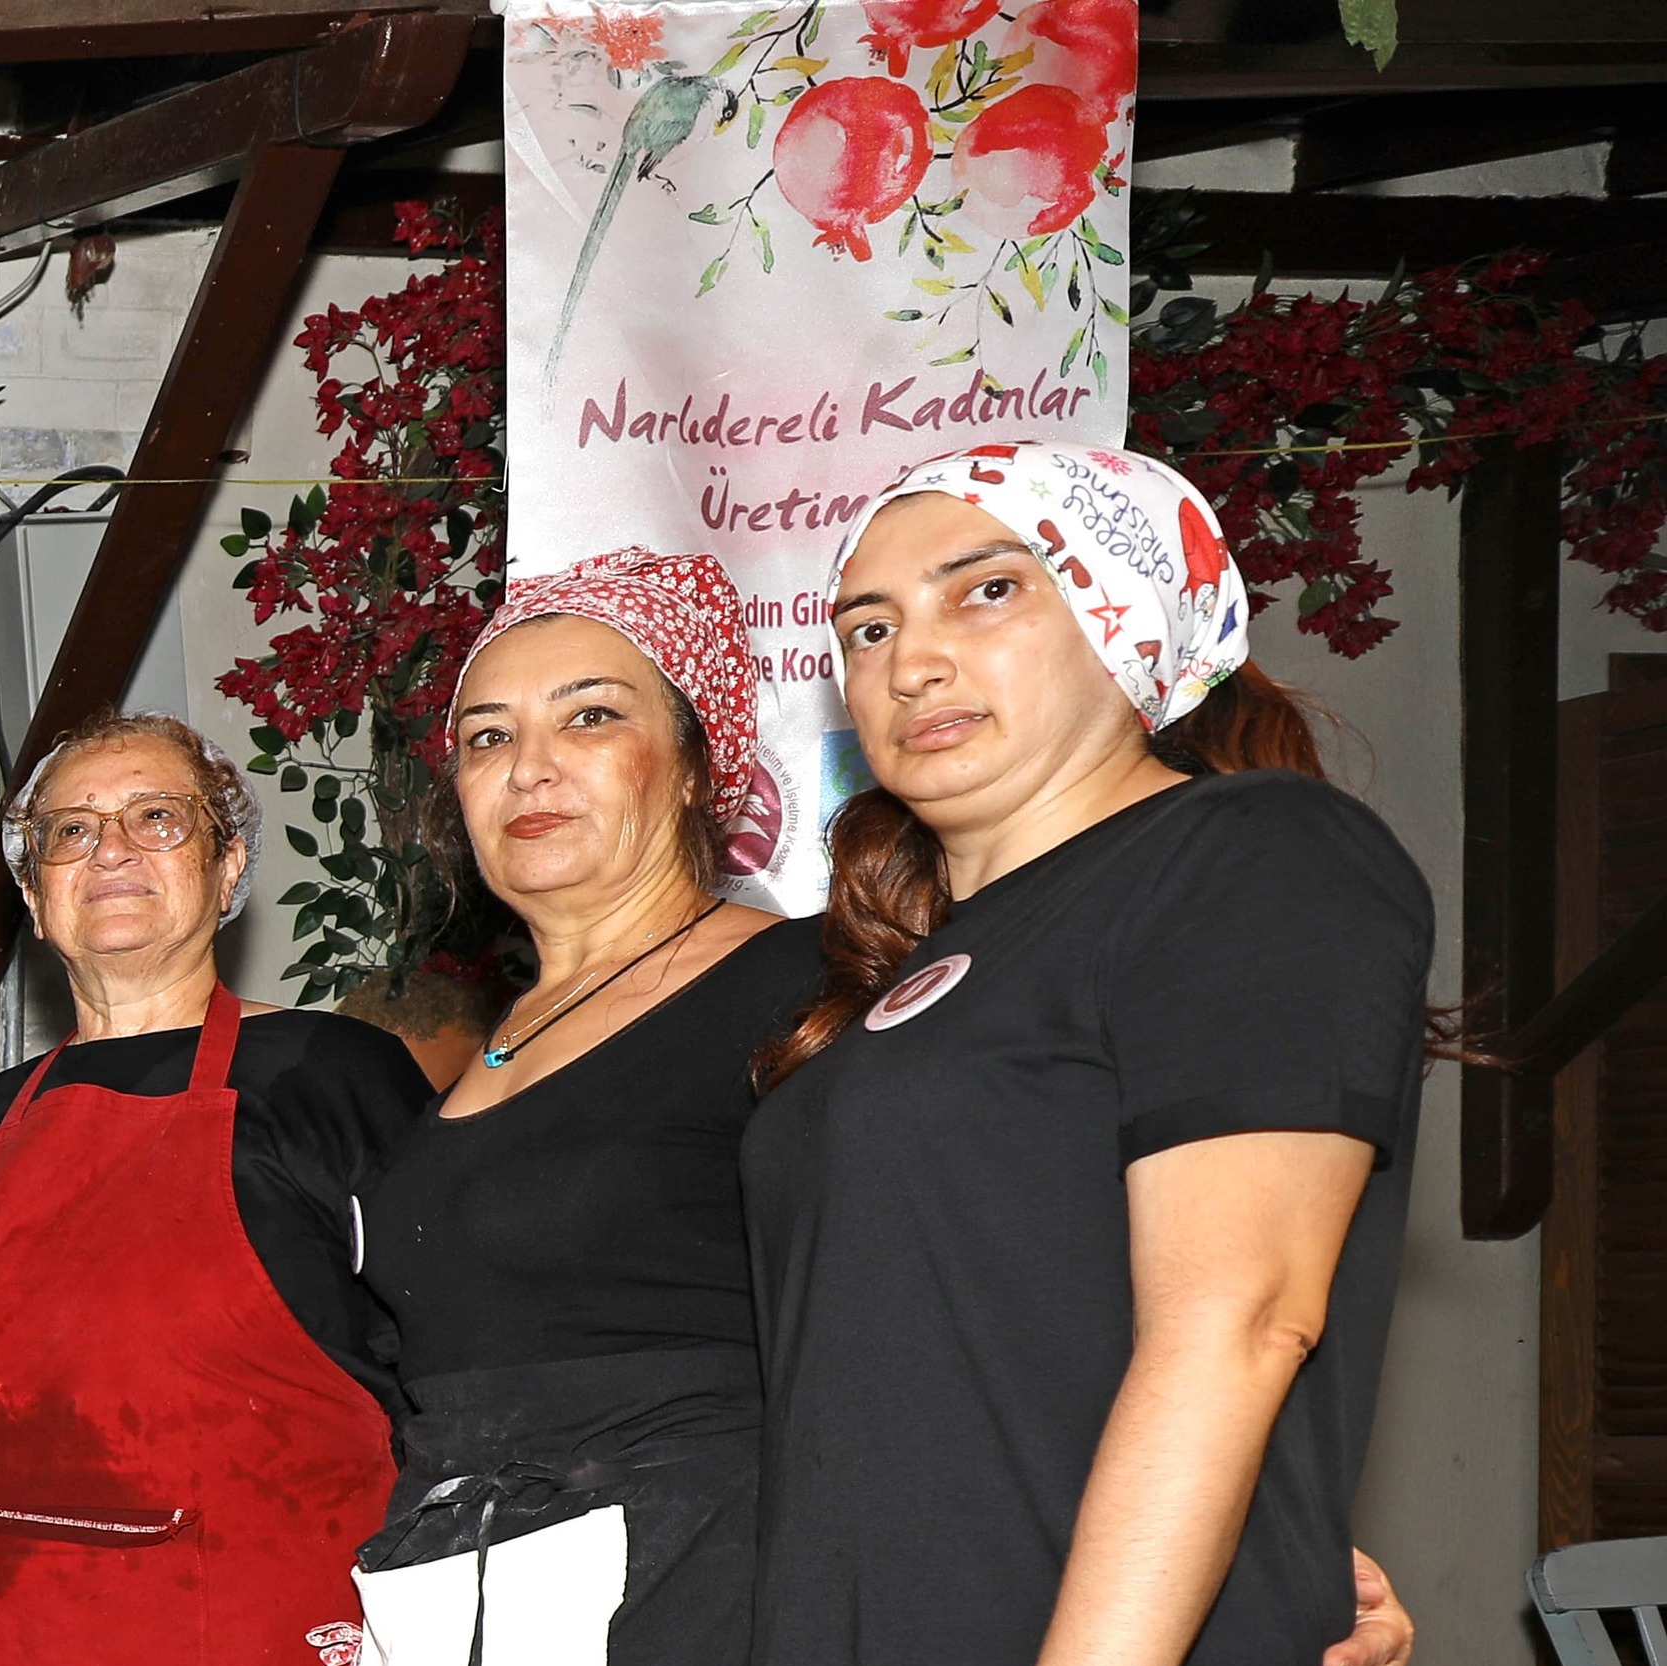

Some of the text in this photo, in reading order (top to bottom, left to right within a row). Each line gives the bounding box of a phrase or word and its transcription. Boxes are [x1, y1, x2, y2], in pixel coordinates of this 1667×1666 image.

[579, 367, 1092, 448] Narlıdereli Kadınlar
[701, 466, 869, 532] Üretim
